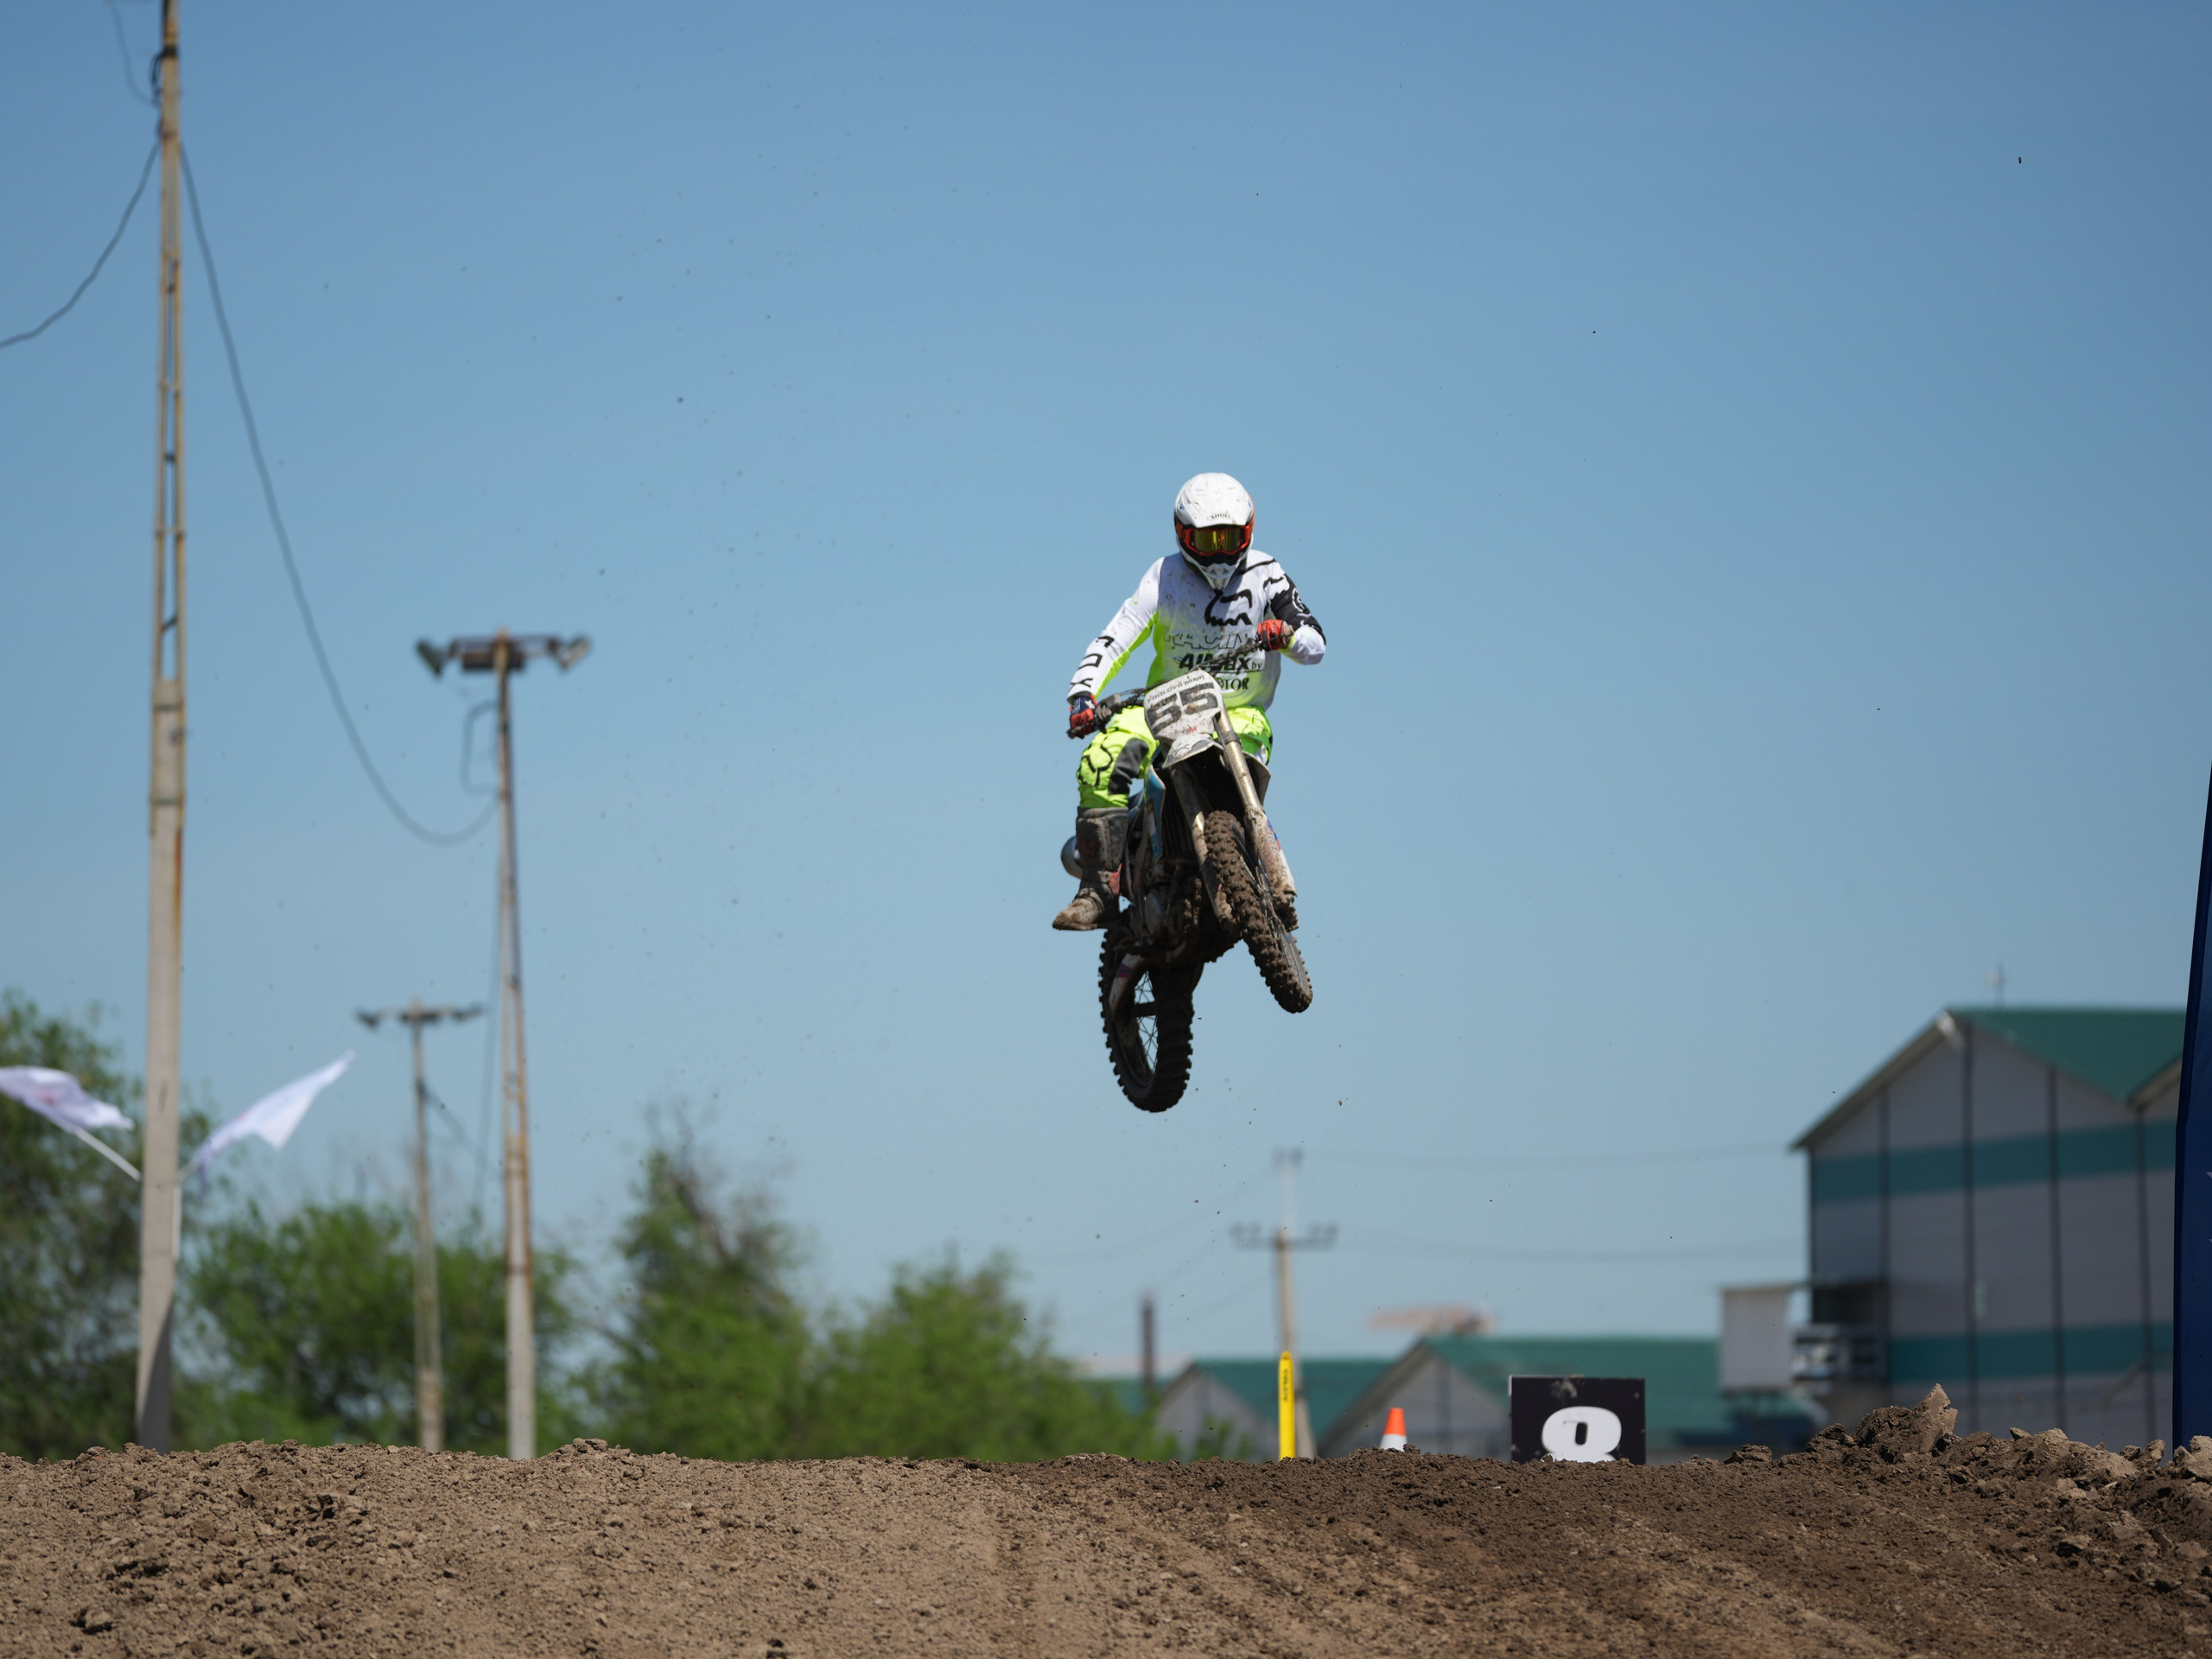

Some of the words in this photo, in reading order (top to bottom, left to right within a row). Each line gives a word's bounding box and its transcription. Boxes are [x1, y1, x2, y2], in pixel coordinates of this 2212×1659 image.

[1252, 661, 1262, 671] by
[1216, 677, 1250, 690] OTOR
[1146, 682, 1218, 735] 55
